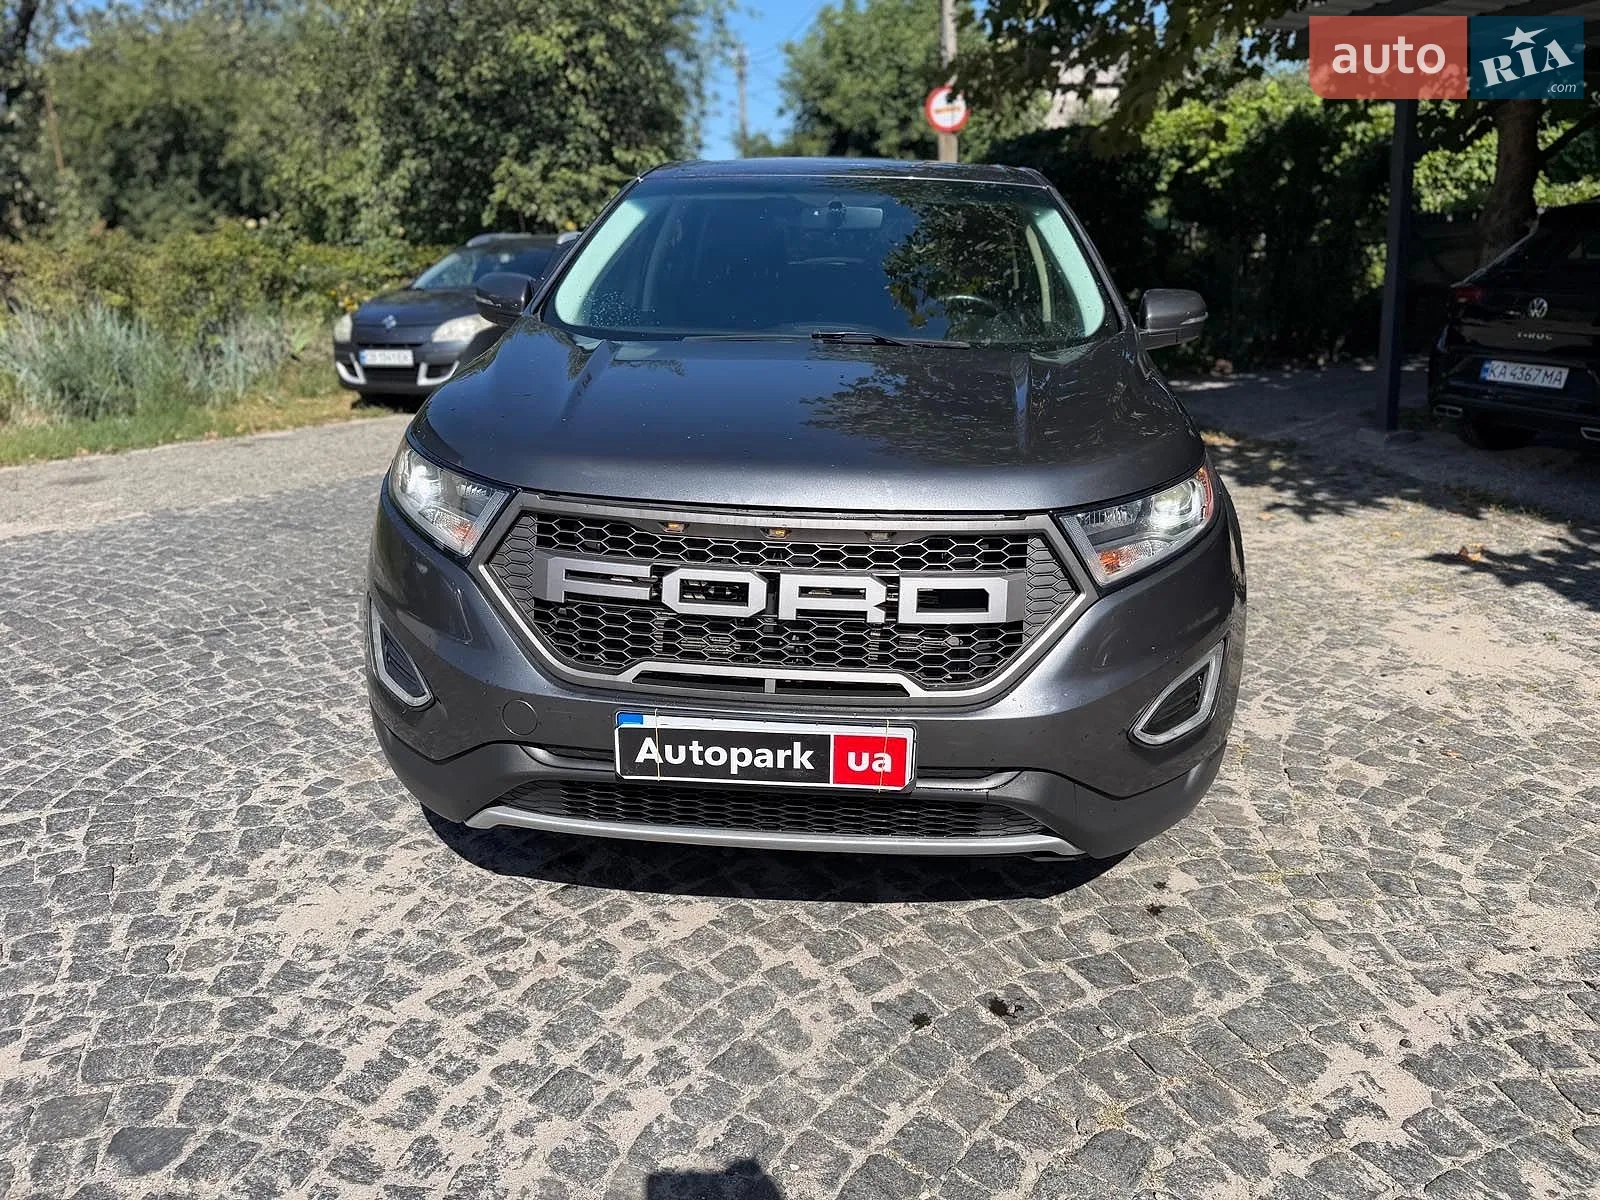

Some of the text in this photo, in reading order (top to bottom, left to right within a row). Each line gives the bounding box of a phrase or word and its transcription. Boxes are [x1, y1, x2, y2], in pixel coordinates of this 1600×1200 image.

[546, 556, 1009, 624] FORD
[634, 736, 893, 775] Autopark ua
